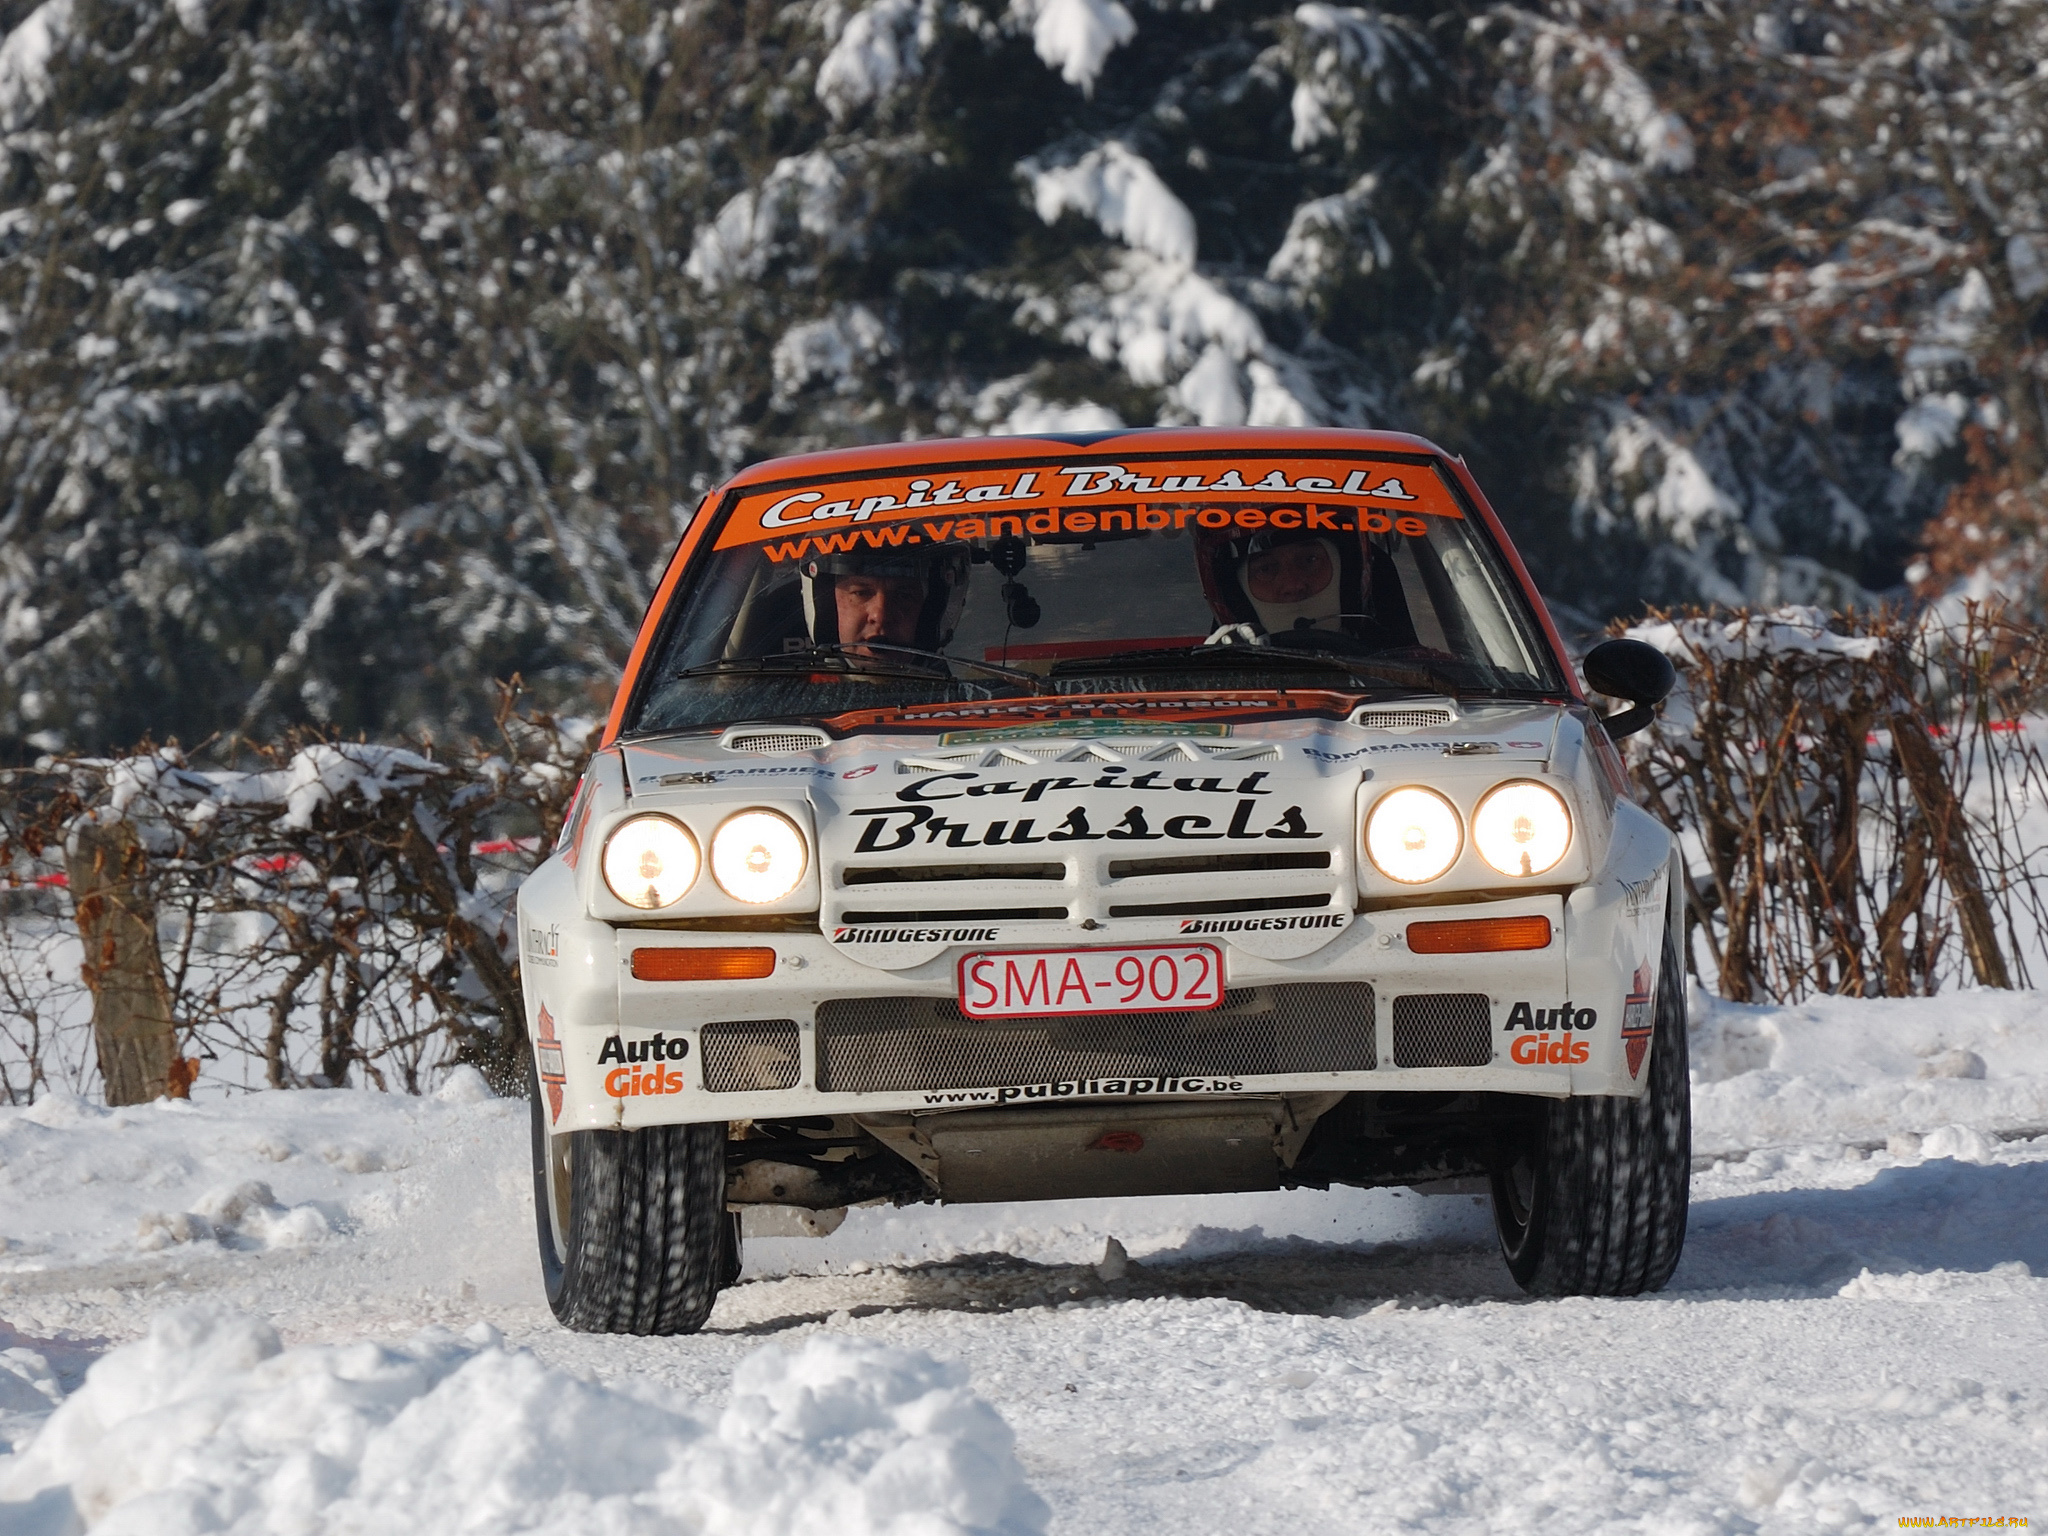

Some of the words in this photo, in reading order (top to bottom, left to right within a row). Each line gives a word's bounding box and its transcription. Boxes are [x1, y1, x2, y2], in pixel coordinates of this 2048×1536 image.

[759, 472, 1043, 529] Capital
[1058, 464, 1419, 500] Brussels
[762, 504, 1428, 563] www.vandenbroeck.be
[904, 700, 1268, 720] HARLEY-DAVIDSON
[896, 766, 1273, 802] Capital
[849, 799, 1323, 853] Brussels
[834, 927, 999, 944] BRIDGESTONE
[1180, 914, 1345, 934] BRIDGESTONE
[971, 953, 1212, 1009] SMA-902
[1503, 1001, 1597, 1031] Auto
[598, 1032, 689, 1065] Auto
[1510, 1032, 1590, 1064] Gids
[604, 1064, 683, 1098] Gids
[923, 1076, 1243, 1104] www.publiaplic.be
